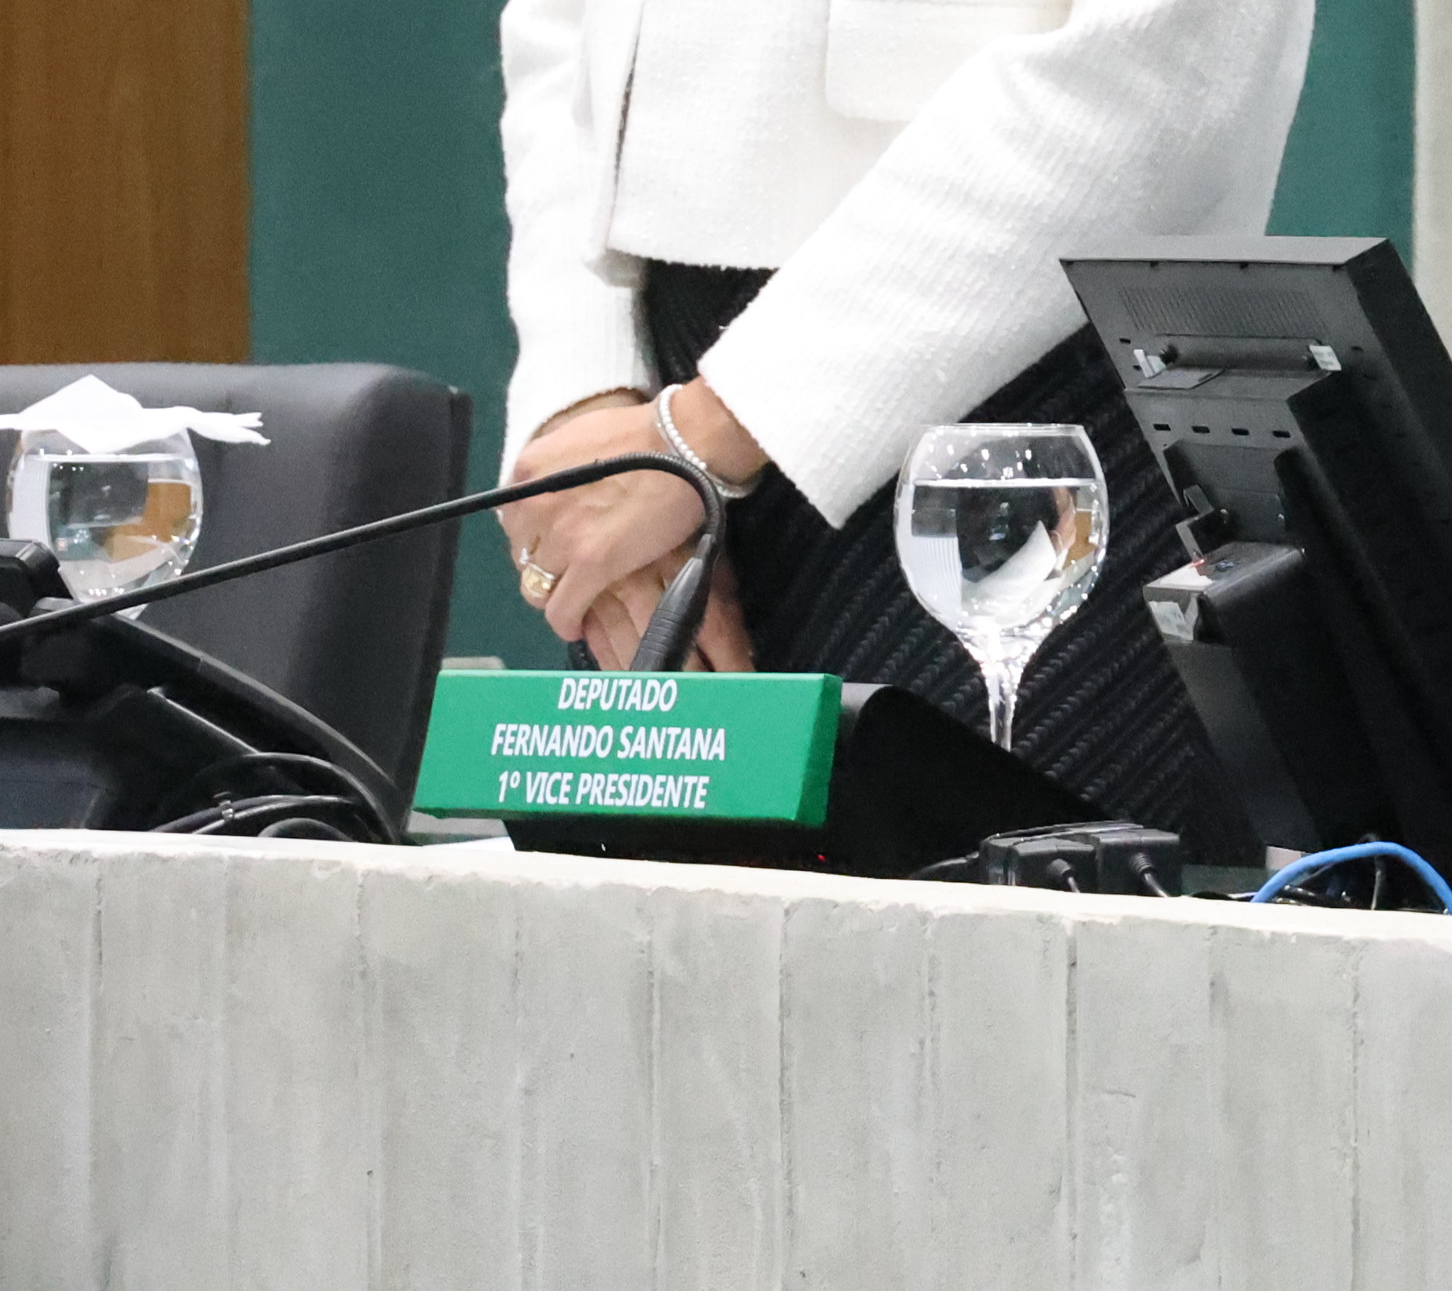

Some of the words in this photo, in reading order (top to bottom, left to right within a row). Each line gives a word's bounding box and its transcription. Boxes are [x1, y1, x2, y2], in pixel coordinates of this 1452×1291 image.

[557, 677, 678, 712] DEPUTADO
[490, 723, 614, 759] FERNANDO
[616, 725, 726, 761] SANTANA
[498, 770, 521, 803] 1º
[525, 771, 574, 805] VICE
[575, 772, 711, 809] PRESIDENTE
